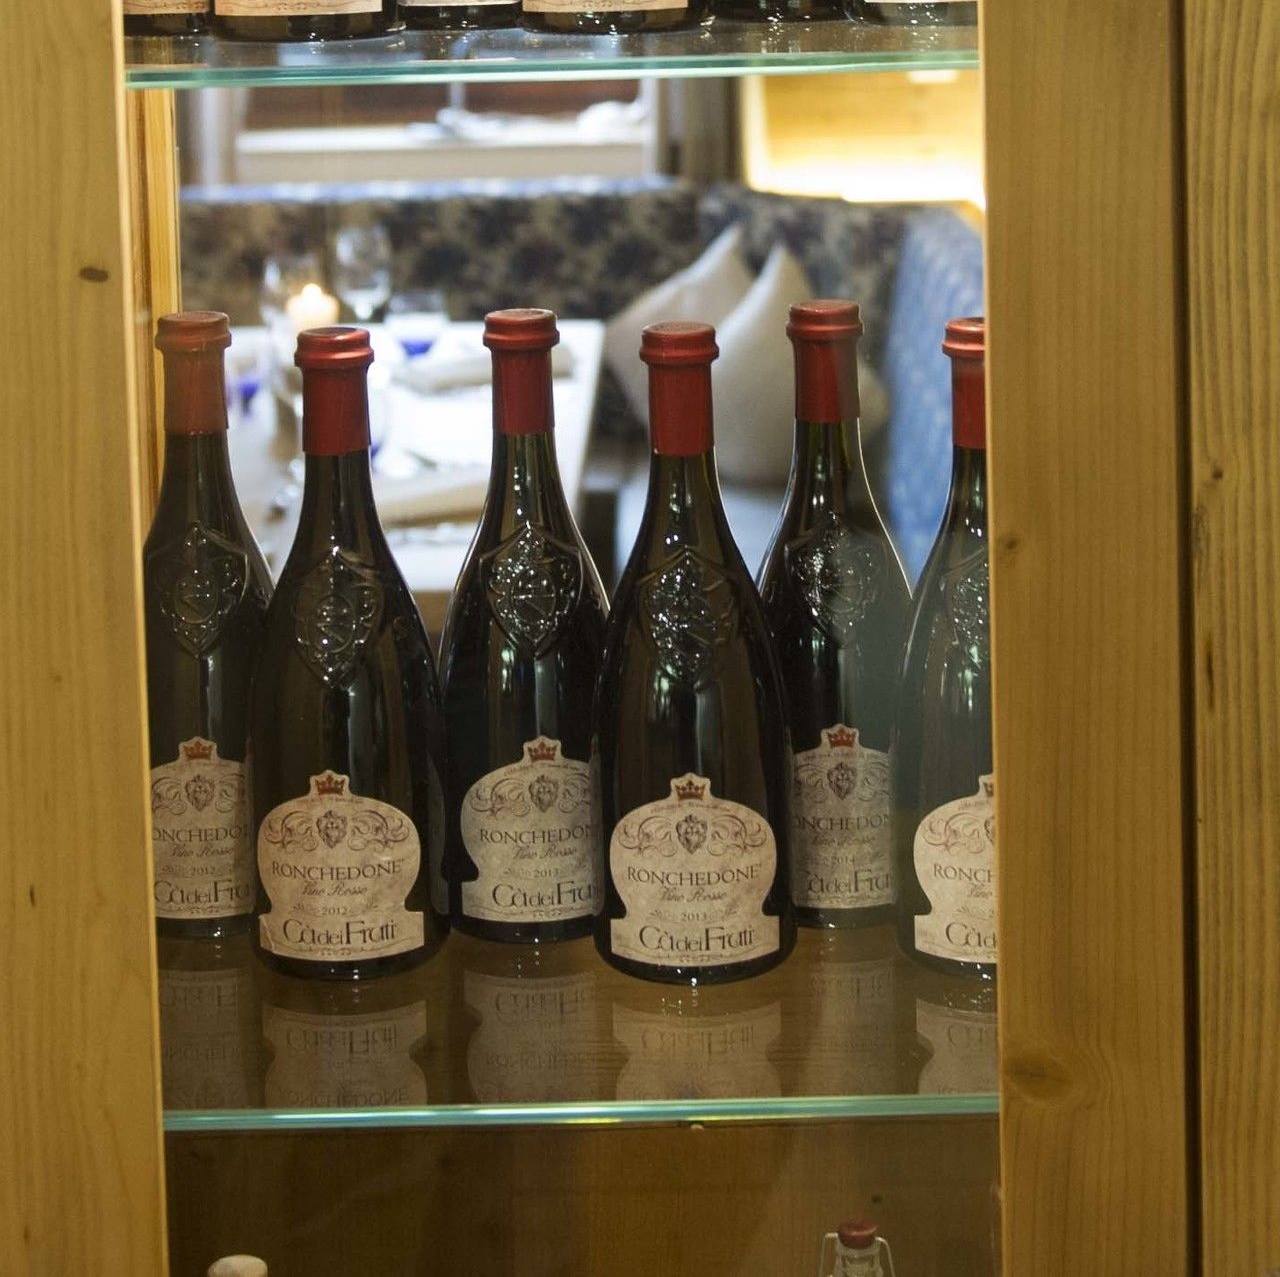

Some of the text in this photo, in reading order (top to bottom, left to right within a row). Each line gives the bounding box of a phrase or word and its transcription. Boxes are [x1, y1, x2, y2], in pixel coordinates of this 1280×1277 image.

[272, 859, 402, 881] RONCHEDONE
[627, 864, 760, 886] RONCHEDONE
[327, 881, 368, 896] Rosso
[322, 906, 348, 916] 2012
